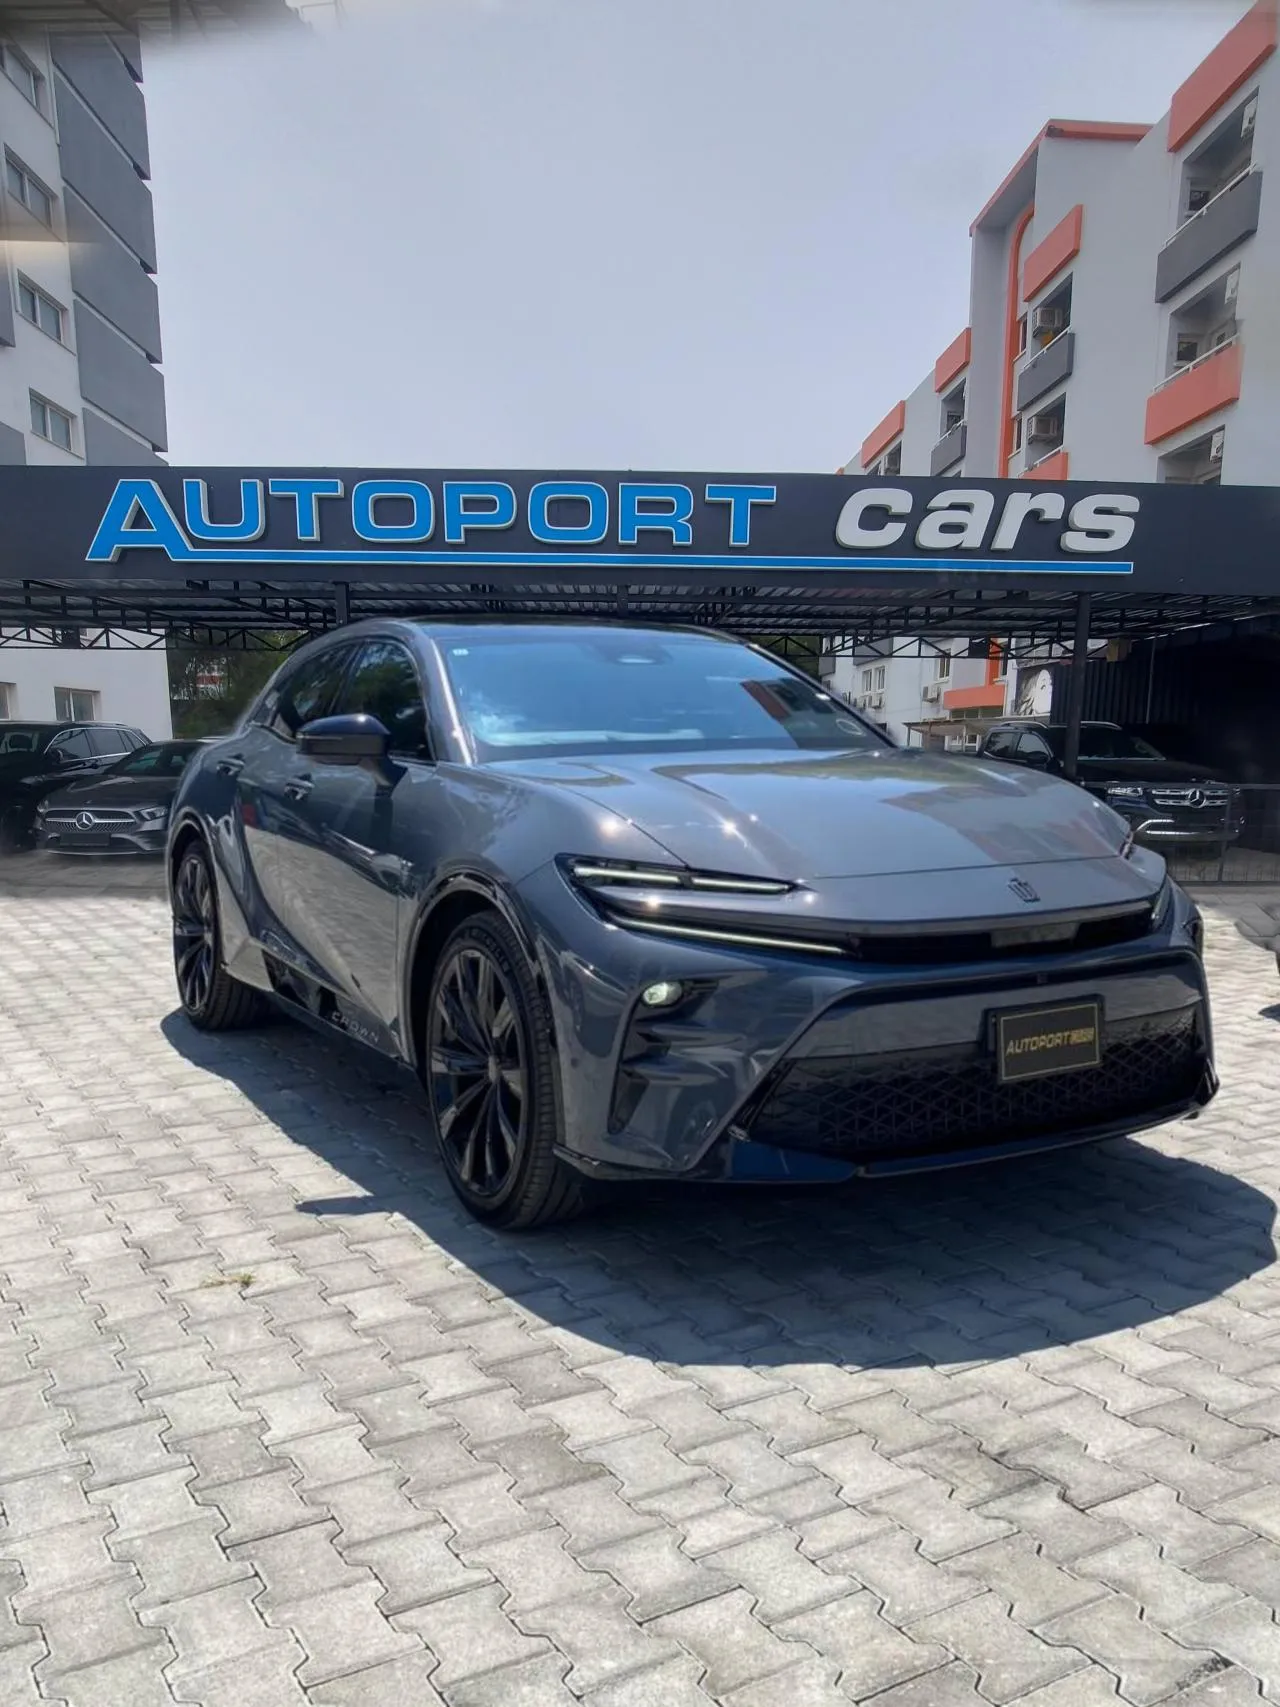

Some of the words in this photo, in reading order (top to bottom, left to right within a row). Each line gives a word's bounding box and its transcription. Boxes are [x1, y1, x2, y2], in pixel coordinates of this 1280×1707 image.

[85, 478, 777, 562] AUTOPORT
[835, 487, 1141, 554] cars
[1006, 1031, 1070, 1055] AUTOPORT
